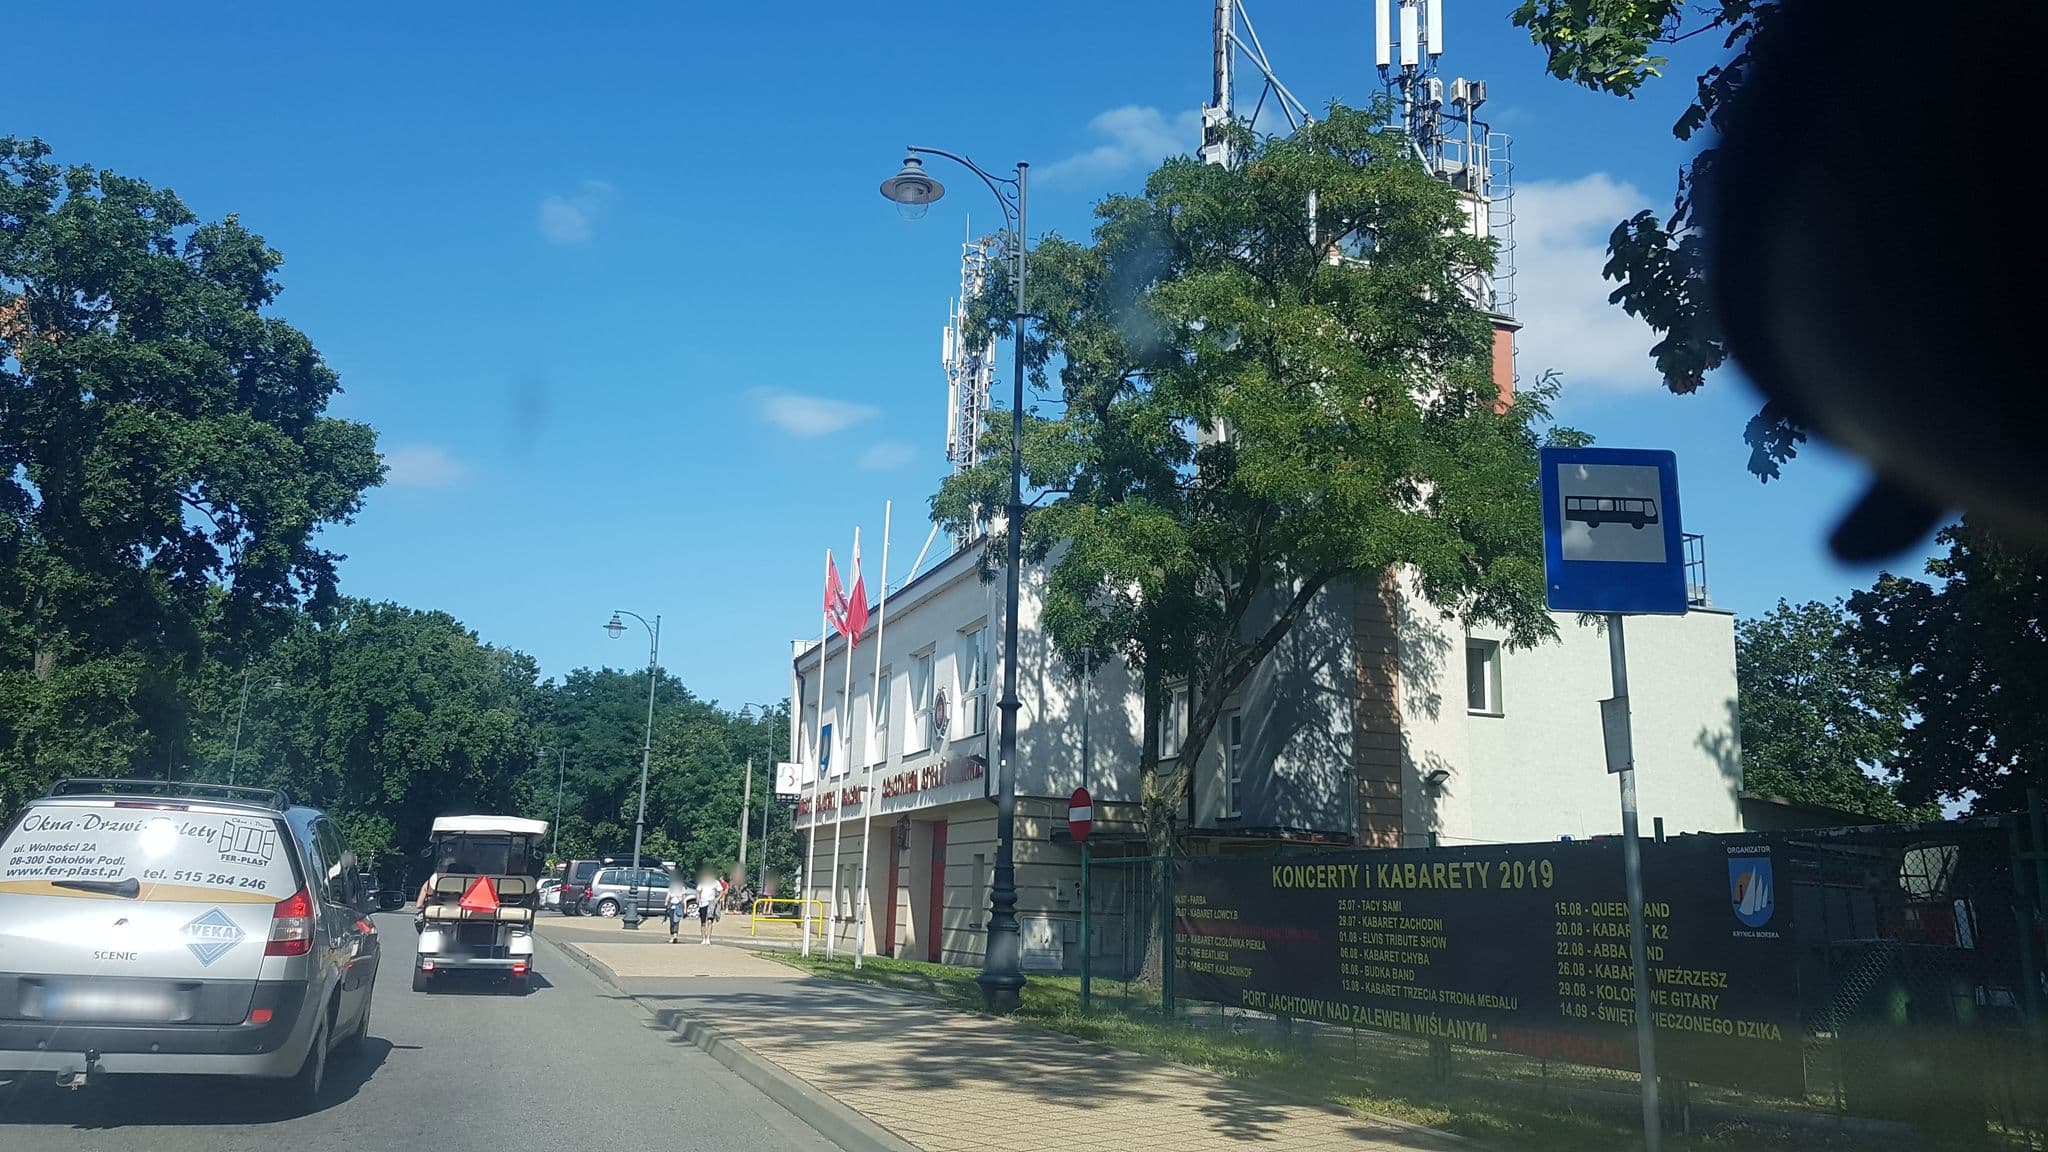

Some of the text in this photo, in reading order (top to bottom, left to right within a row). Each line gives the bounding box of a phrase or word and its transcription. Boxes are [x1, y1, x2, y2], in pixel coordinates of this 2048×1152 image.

[23, 814, 72, 832] Okna
[152, 817, 218, 844] lety
[14, 844, 24, 853] ul.
[81, 843, 96, 852] 2A
[1727, 846, 1771, 854] ORGANIZATOR
[10, 856, 126, 866] 08-300 Sokołów Podl.
[220, 854, 268, 866] FER-PLAST
[6, 866, 124, 878] www.fer-plast.pl
[143, 869, 266, 890] tel. 515 264 246
[1272, 860, 1554, 889] KONCERTY i KABARETY 2019
[1338, 900, 1356, 911] 25.07
[1360, 900, 1380, 912] TACY
[1382, 900, 1402, 912] SAMI
[1554, 902, 1582, 916] 15.08
[1644, 903, 1670, 918] AND
[191, 925, 234, 938] VEKA
[1362, 916, 1398, 930] KABARET
[1400, 918, 1443, 931] ZACHODNI
[1556, 922, 1582, 936] 20.08
[1652, 924, 1668, 940] K2
[1362, 932, 1384, 945] ELVIS
[1385, 934, 1419, 947] TRIBUTE
[1420, 936, 1447, 949] SHOW
[94, 951, 138, 960] SCENIC
[1363, 948, 1400, 963] KABARET
[1401, 952, 1430, 966] CHYBA
[1557, 942, 1584, 956] 22.08
[1594, 944, 1627, 958] ABBA
[1364, 966, 1390, 979] BUDKA
[1392, 968, 1415, 981] BAND
[1558, 962, 1584, 976] 26.08
[1655, 966, 1728, 989] WEŹRZESZ
[1365, 982, 1400, 997] KABARET
[1402, 985, 1438, 1000] TRZECIA
[1438, 990, 1475, 1005] STRONA
[1477, 993, 1518, 1010] MEDALU
[1559, 982, 1586, 996] 29.08
[1671, 990, 1719, 1011] GITARY
[1242, 989, 1266, 1008] PORT
[1268, 993, 1324, 1018] JACHTOWY
[1326, 1003, 1350, 1021] NAD
[1352, 1004, 1411, 1031] ZALEWEM
[1412, 1011, 1488, 1042] WIŚLANYM
[1560, 1002, 1588, 1018] 14.09
[1737, 1020, 1782, 1042] DZIKA
